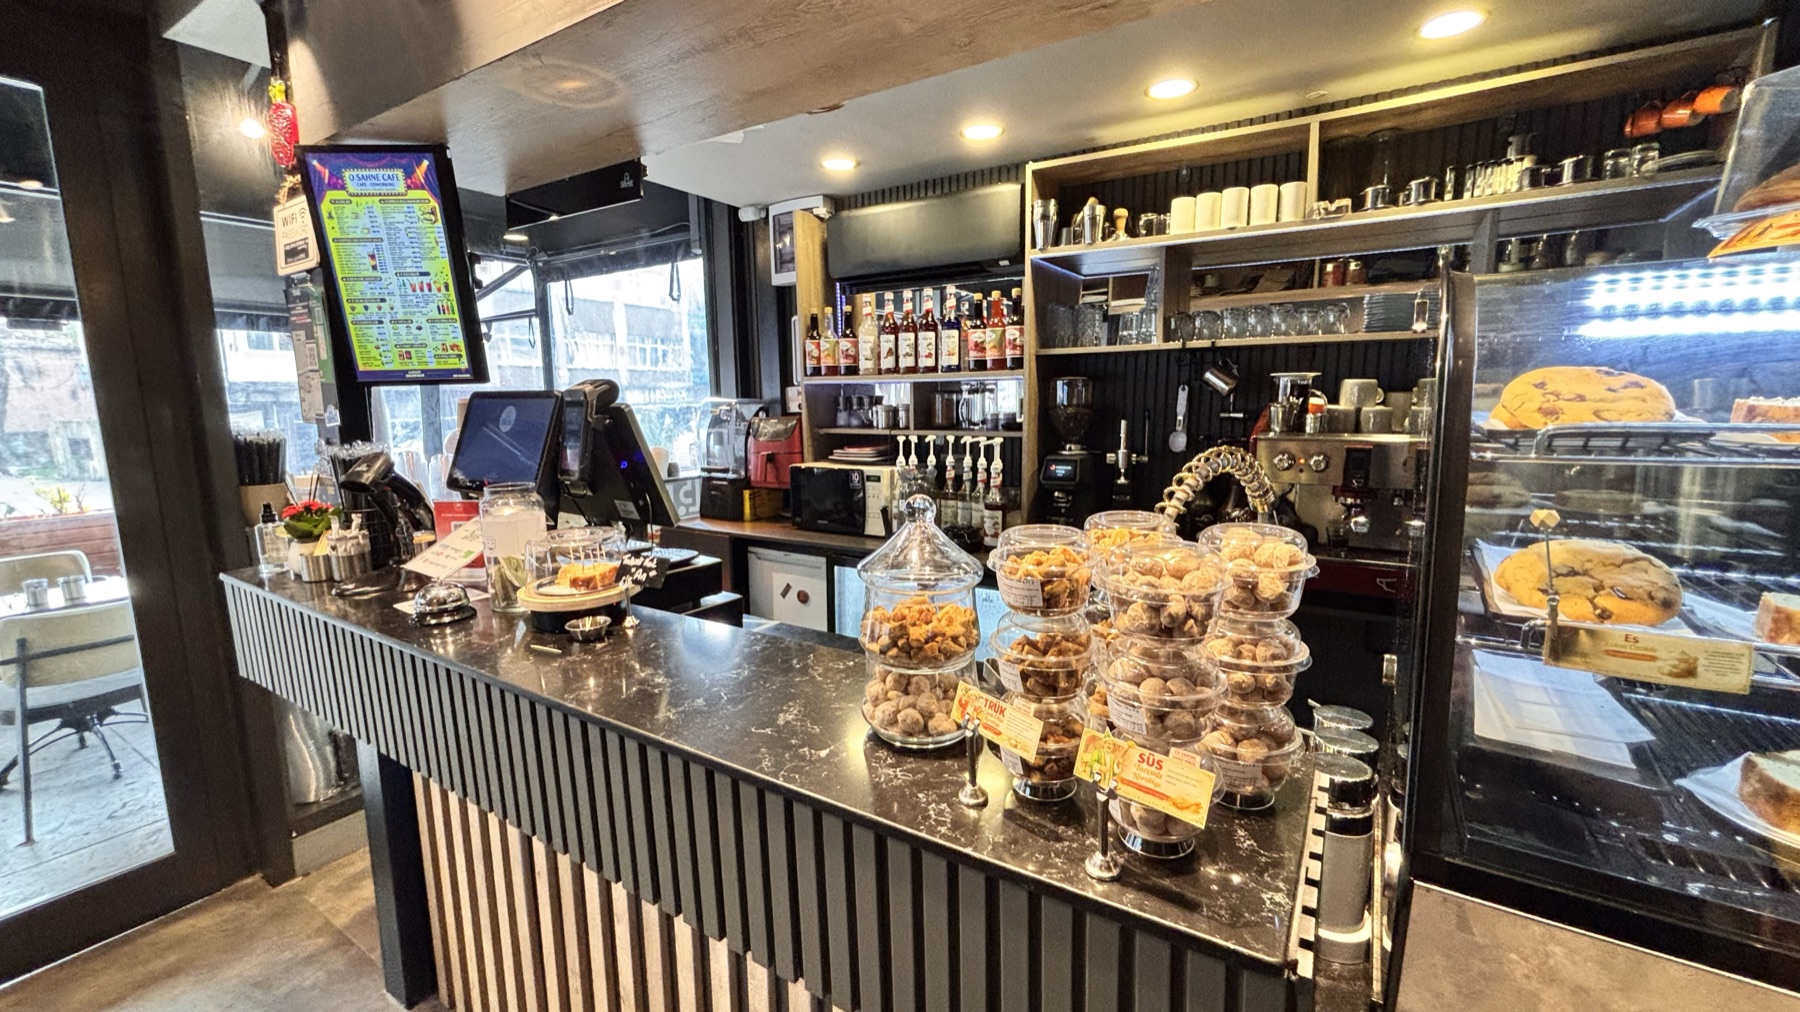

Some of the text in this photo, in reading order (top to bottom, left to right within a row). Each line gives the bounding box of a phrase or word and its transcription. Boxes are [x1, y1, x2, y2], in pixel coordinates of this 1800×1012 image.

[356, 173, 380, 181] SAHNE
[382, 173, 400, 181] CAFE
[282, 212, 298, 228] WIFI
[1624, 633, 1641, 644] Es
[1137, 752, 1164, 771] SÜS
